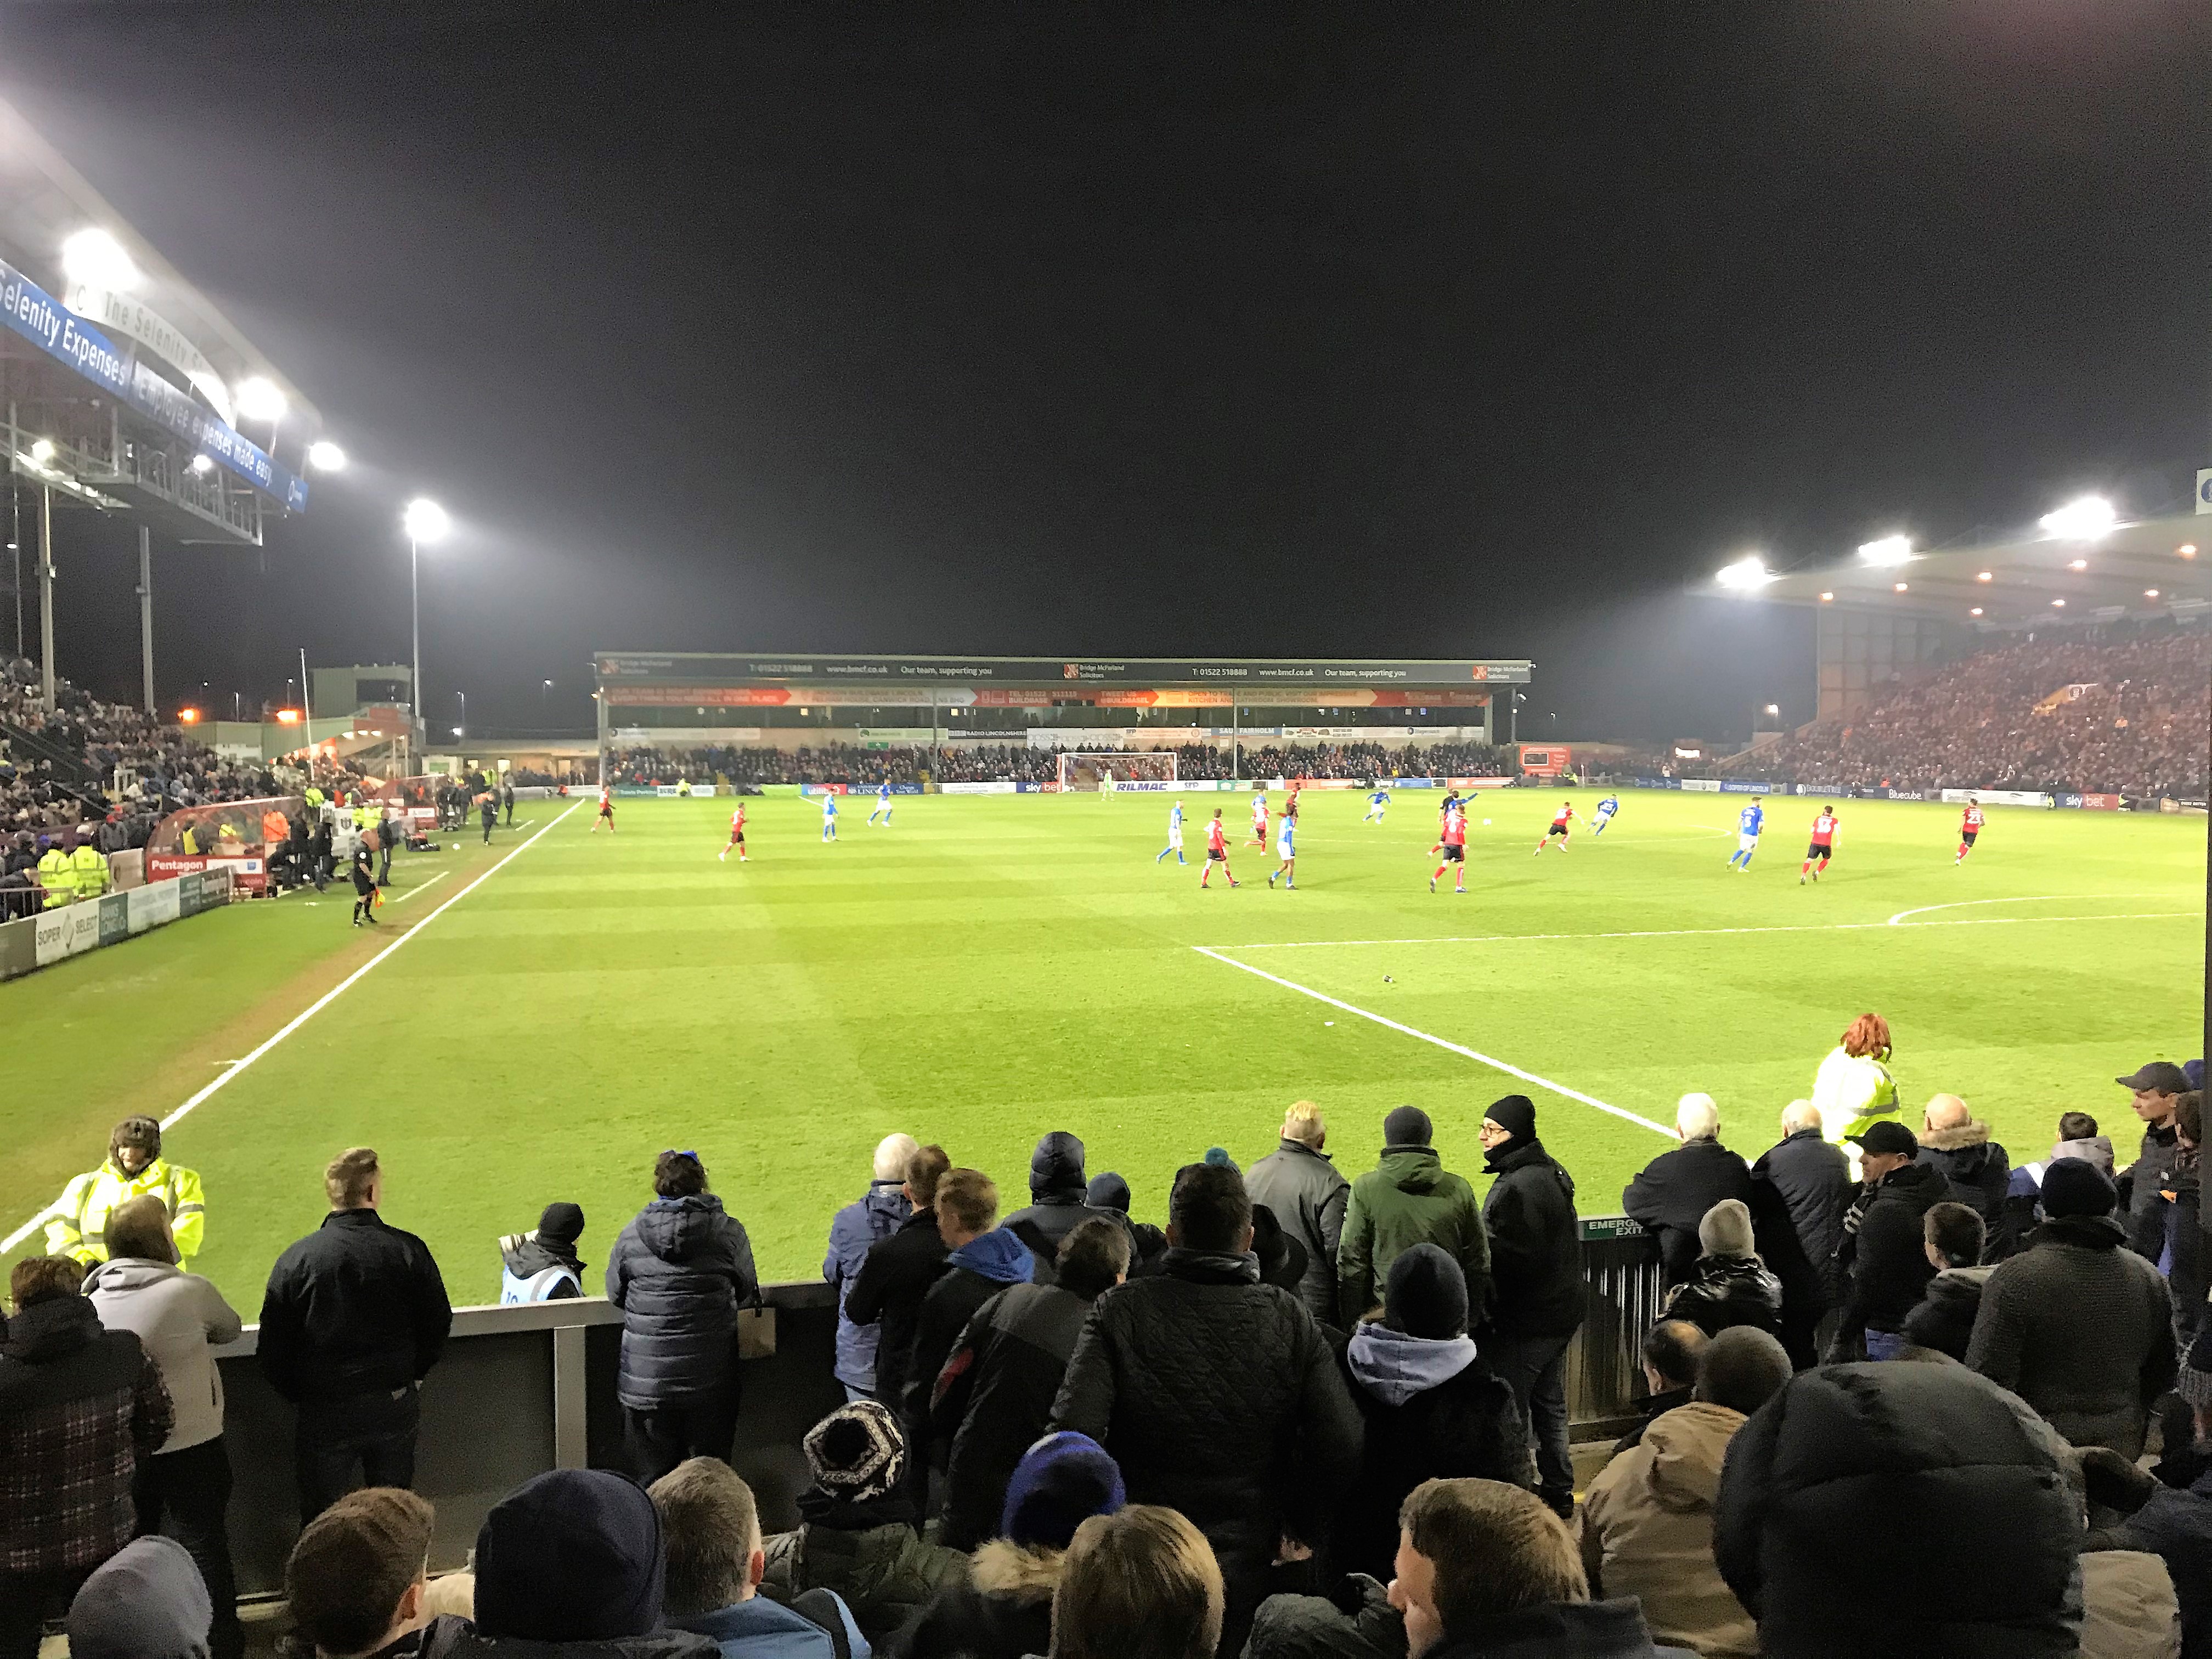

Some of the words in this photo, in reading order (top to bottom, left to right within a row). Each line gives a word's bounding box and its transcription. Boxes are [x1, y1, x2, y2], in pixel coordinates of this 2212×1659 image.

[105, 290, 129, 325] The
[135, 307, 187, 365] Selenity
[63, 318, 125, 386] Expenses
[138, 377, 189, 428] Employee
[233, 444, 255, 471] made
[917, 667, 937, 675] team,
[939, 667, 978, 676] supporting
[1359, 669, 1393, 678] supporting
[1025, 782, 1042, 793] sky
[1044, 783, 1061, 792] bet
[1116, 783, 1168, 791] RILMAC
[1888, 788, 1922, 800] Bluecube
[2066, 794, 2083, 809] sky
[2085, 795, 2105, 807] bet
[1966, 814, 1981, 824] 23
[151, 860, 204, 871] Pentagon
[38, 926, 60, 946] SOPER
[76, 915, 98, 934] SELECT
[1616, 1226, 1643, 1236] EXIT
